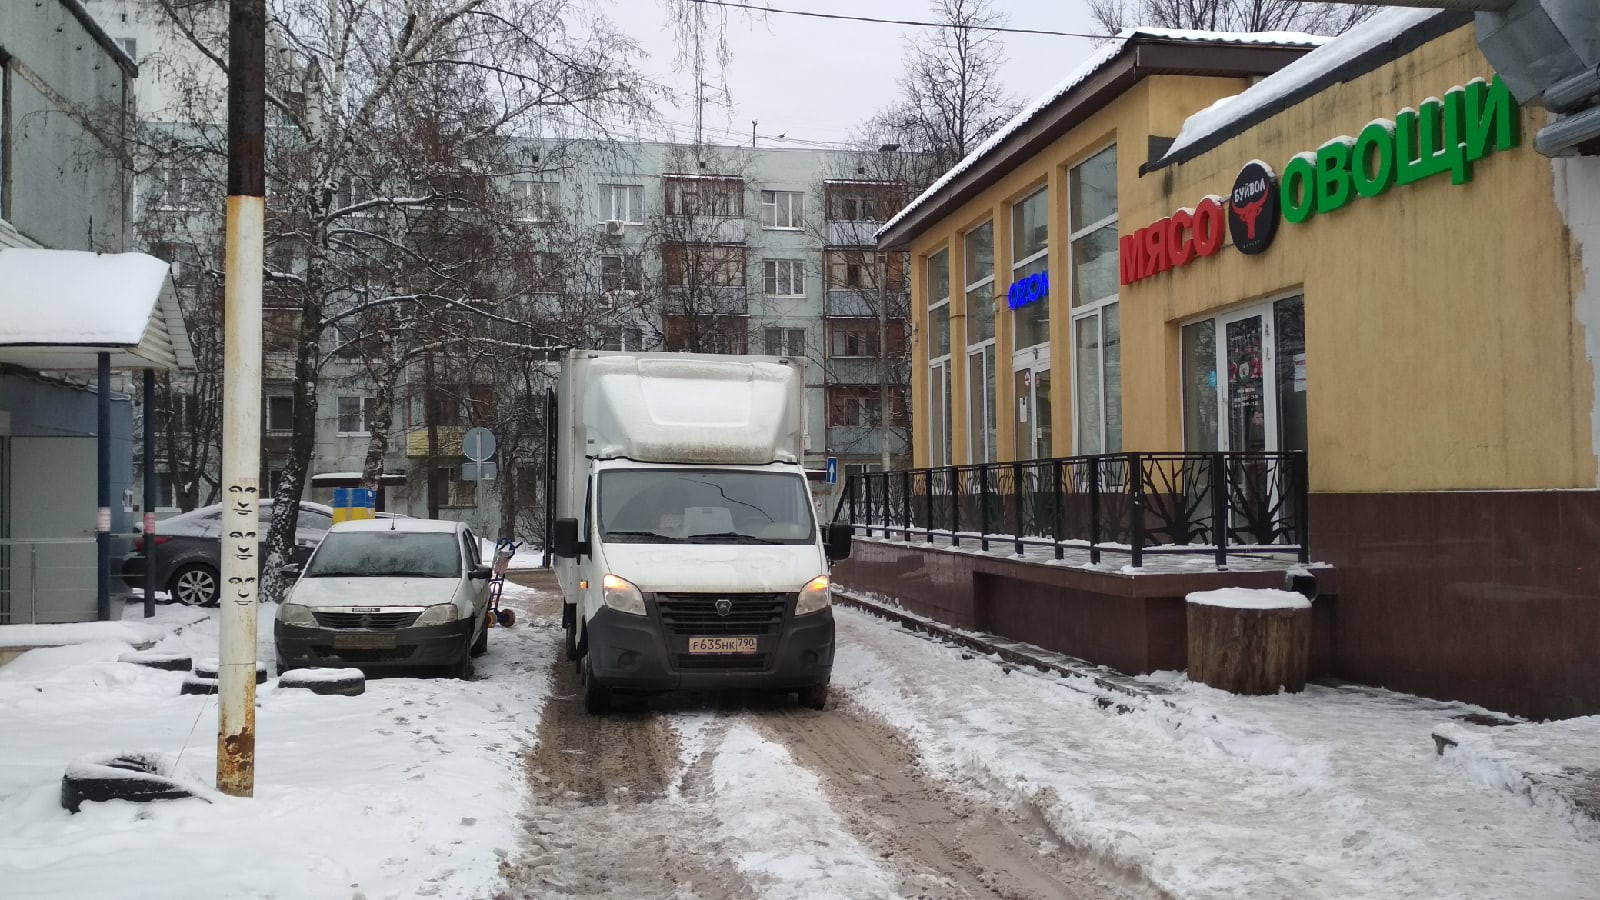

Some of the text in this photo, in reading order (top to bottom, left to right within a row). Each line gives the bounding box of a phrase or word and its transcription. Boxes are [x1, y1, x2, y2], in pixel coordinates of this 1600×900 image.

[1119, 72, 1521, 286] МЯСО ОВОЩИ
[1234, 177, 1266, 203] БУЙВОЛ
